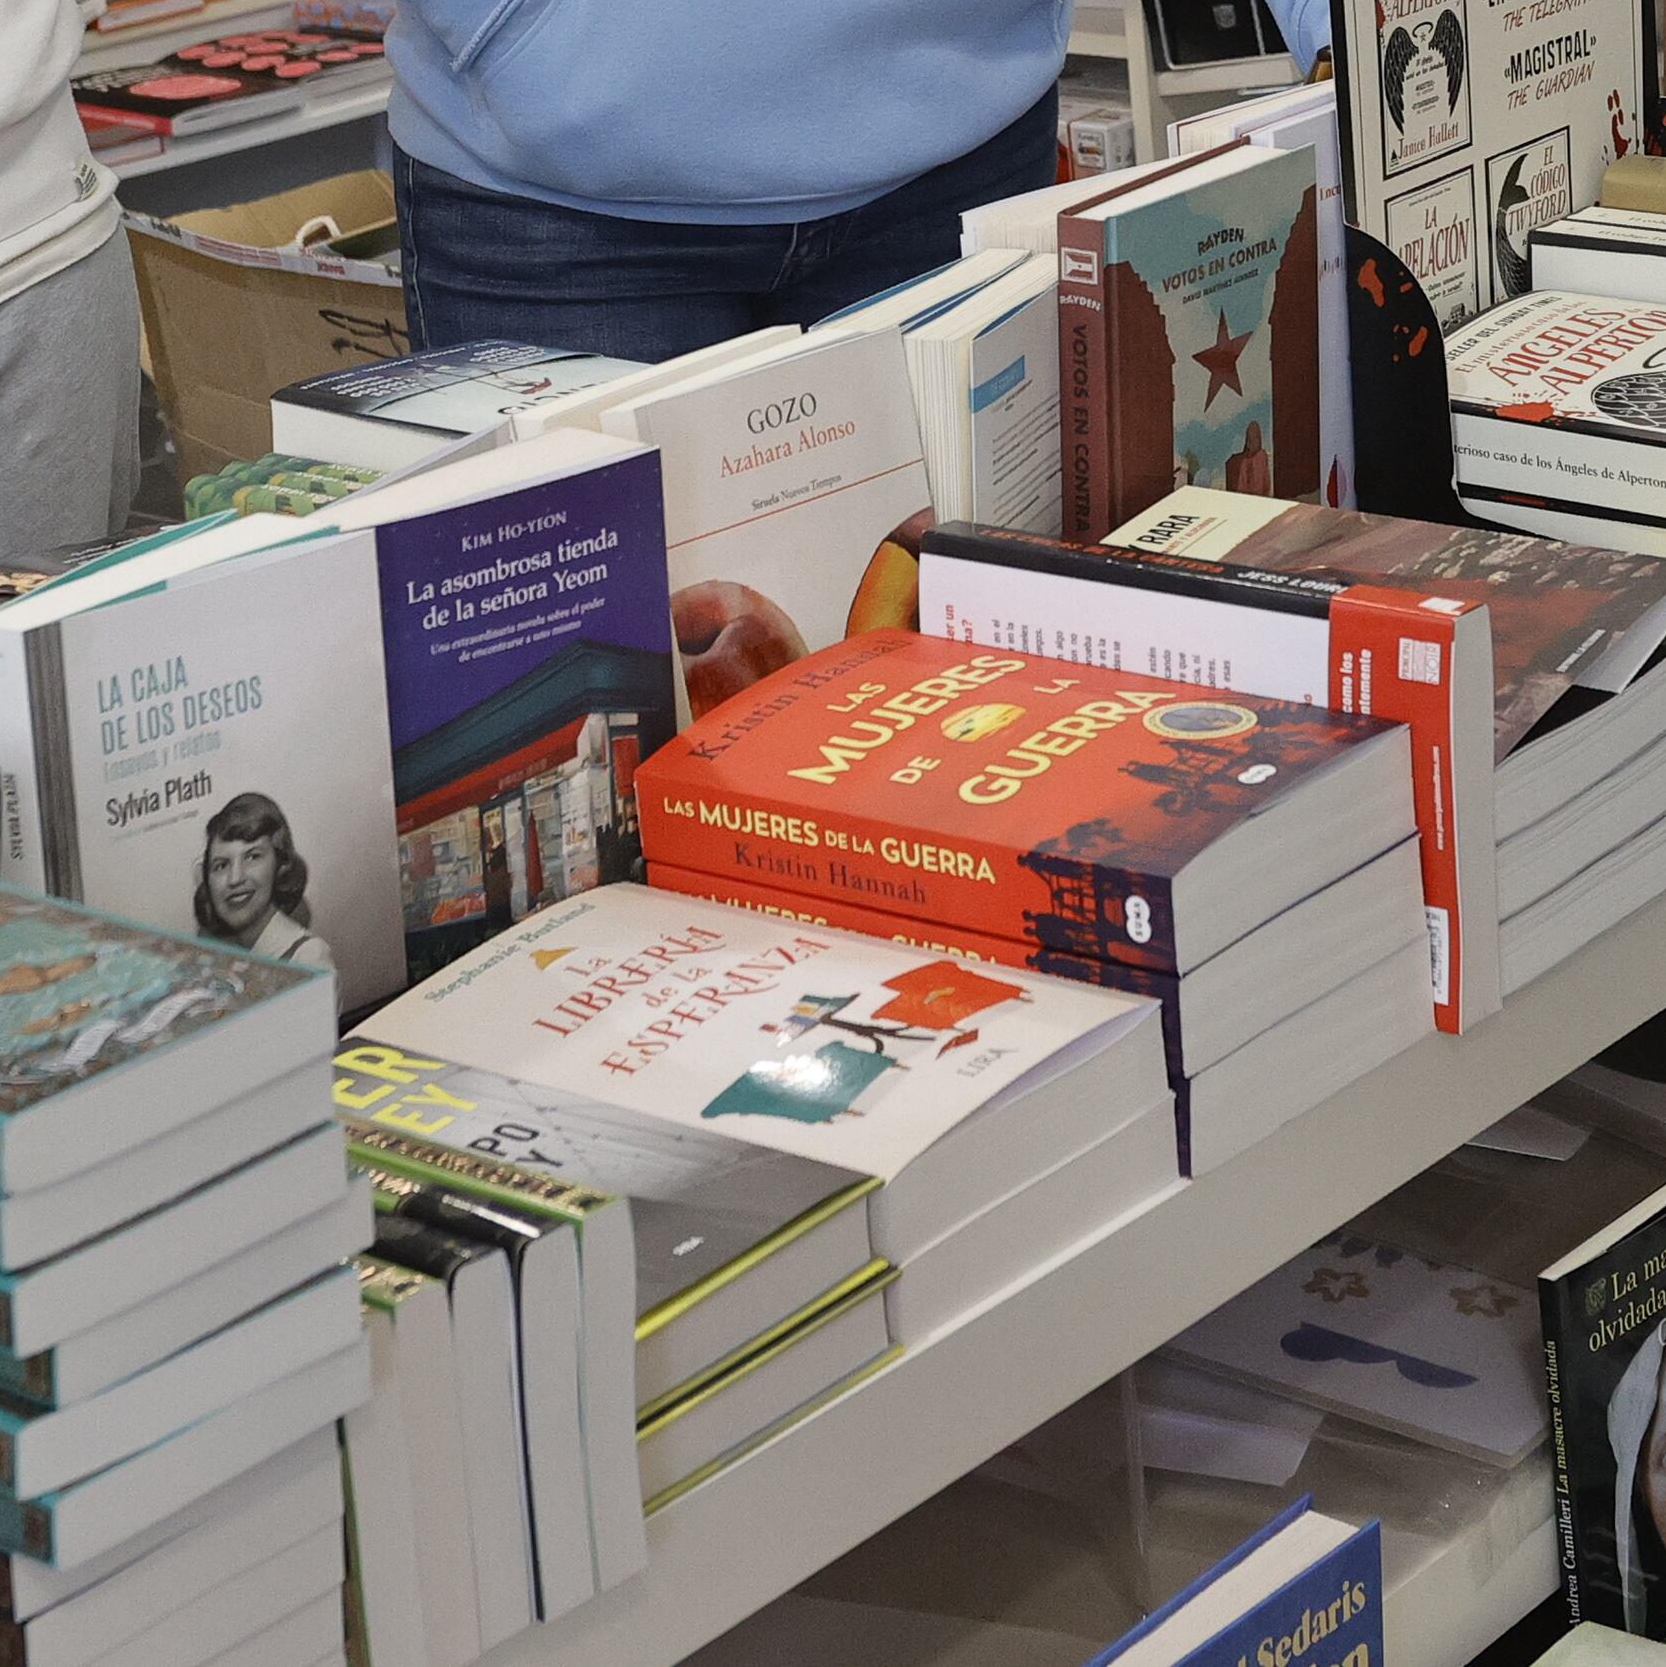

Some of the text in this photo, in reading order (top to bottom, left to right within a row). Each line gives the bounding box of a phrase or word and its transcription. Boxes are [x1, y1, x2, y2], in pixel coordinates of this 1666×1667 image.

[1503, 11, 1526, 32] THE
[1504, 30, 1596, 84] «MAGISTRAL»
[1507, 61, 1595, 110] THE GUARDIAN
[1531, 164, 1565, 198] CÓDIGO
[1544, 146, 1553, 165] EL
[1425, 206, 1437, 230] LA
[1508, 190, 1566, 235] TWYFORD
[1163, 238, 1277, 292] VOTOS EN CONTRA
[1197, 228, 1244, 256] RAYDEN
[1060, 295, 1101, 312] RAYDEN
[1487, 308, 1627, 387] ÁNGELES
[745, 393, 817, 435] GOZO
[1069, 324, 1093, 533] VOTOS EN CONTRA
[720, 420, 856, 478] Azahara Alonso
[1454, 444, 1489, 460] terioso
[1493, 449, 1517, 462] caso
[1521, 455, 1533, 466] de
[1536, 455, 1552, 469] los
[1555, 457, 1598, 478] Ángeles
[1601, 466, 1615, 479] de
[406, 528, 618, 604] La asombrosa tienda
[462, 533, 492, 552] KIM
[422, 606, 450, 630] de
[456, 599, 474, 622] la
[481, 581, 548, 615] señora
[552, 563, 608, 594] Yeom
[97, 656, 189, 714] LA CAJA
[687, 636, 914, 764] Kristin Hannah
[827, 682, 886, 712] LAS
[100, 676, 263, 755] DE LOS DESEOS
[788, 655, 1027, 786] MUJERES
[891, 676, 1078, 785] DE LA
[958, 689, 1177, 805] GUERRA
[106, 769, 213, 828] Sylvia Plath
[663, 797, 996, 884] LAS MUJERES DE LA GUERRA
[734, 842, 927, 903] Kristin Hannah
[424, 943, 520, 1003] Stephanie
[533, 924, 726, 1038] LIBRERÍA
[565, 954, 613, 981] La
[646, 965, 710, 1009] de la
[600, 936, 833, 1076] ESPERANZA
[1609, 1268, 1638, 1303] La
[1255, 1579, 1367, 1656] Sedaris
